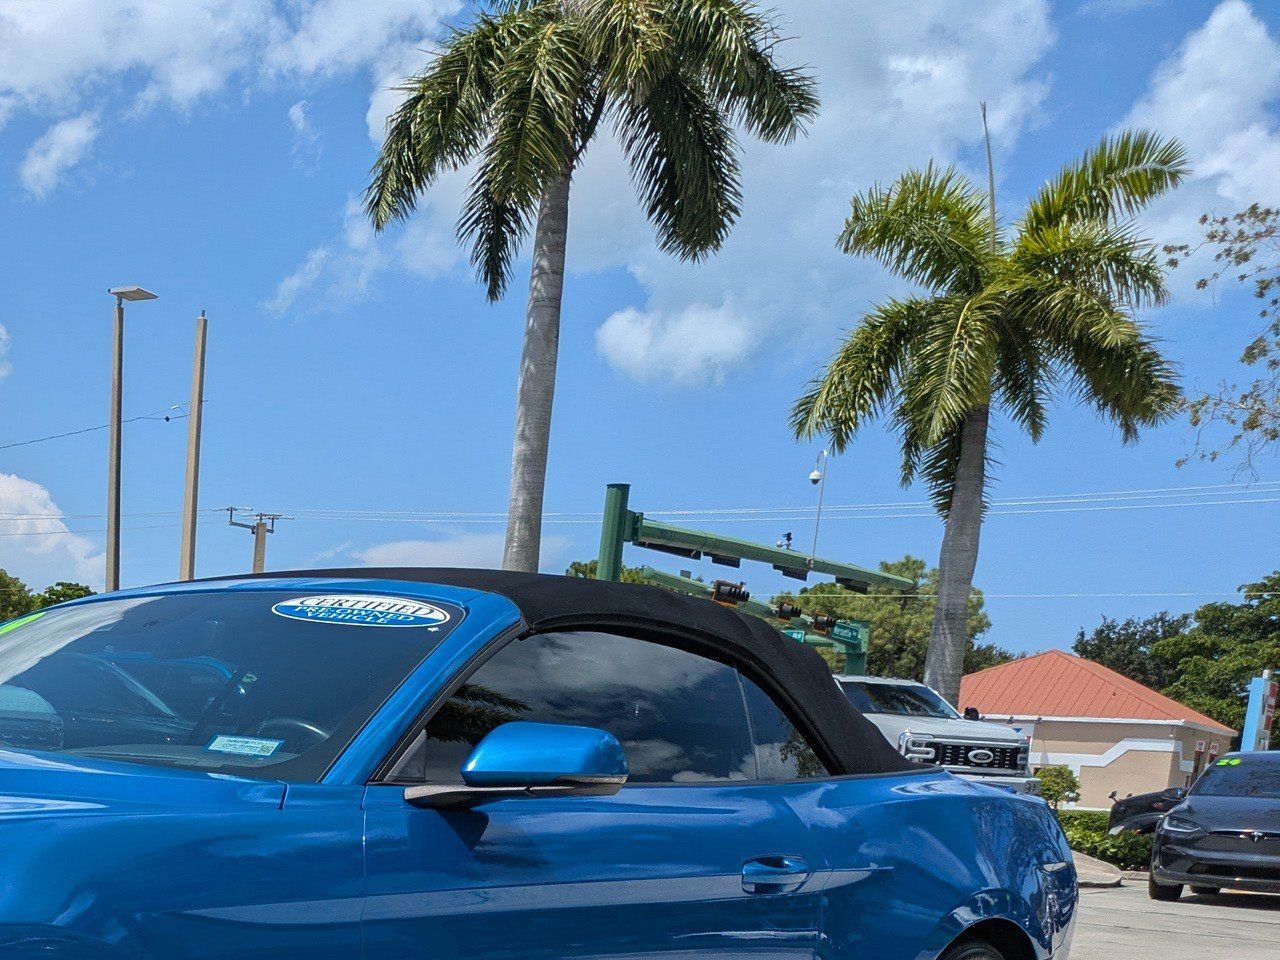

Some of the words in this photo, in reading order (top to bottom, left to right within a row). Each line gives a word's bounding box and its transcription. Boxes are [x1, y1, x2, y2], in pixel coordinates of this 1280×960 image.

[293, 605, 415, 622] PRE-OWNED
[299, 597, 435, 616] CERTIFIED
[307, 612, 389, 624] VEHICLE
